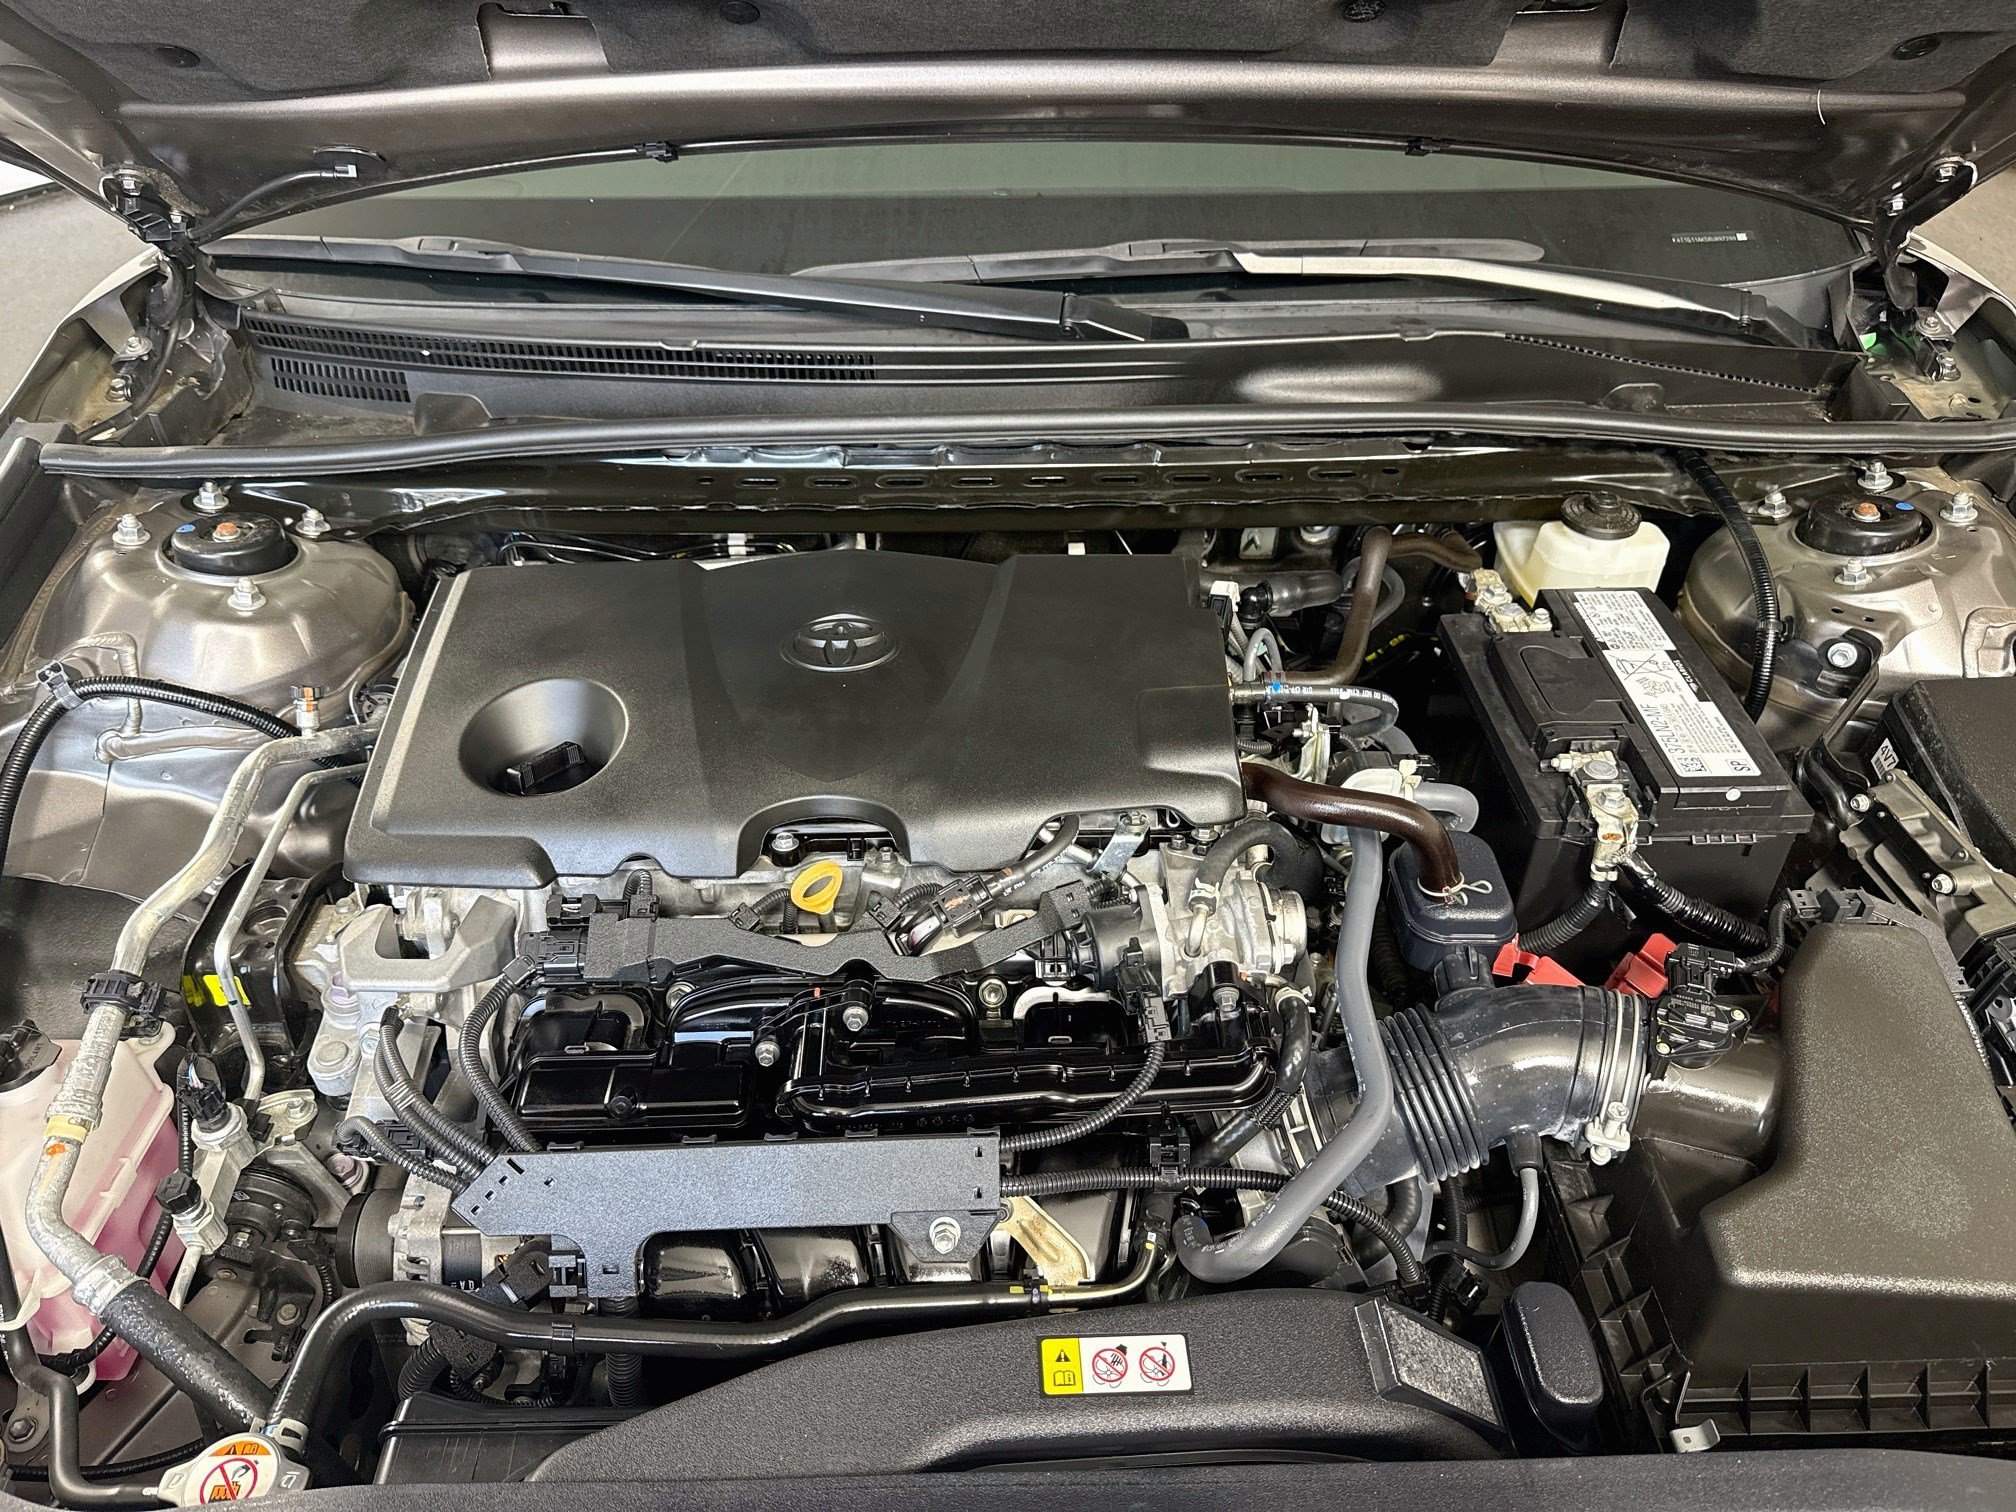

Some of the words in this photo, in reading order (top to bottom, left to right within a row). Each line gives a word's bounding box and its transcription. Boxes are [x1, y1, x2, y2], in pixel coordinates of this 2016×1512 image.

[1640, 703, 1685, 754] 375LN2-MF
[1730, 760, 1752, 772] SP
[1881, 745, 1897, 768] 4V7
